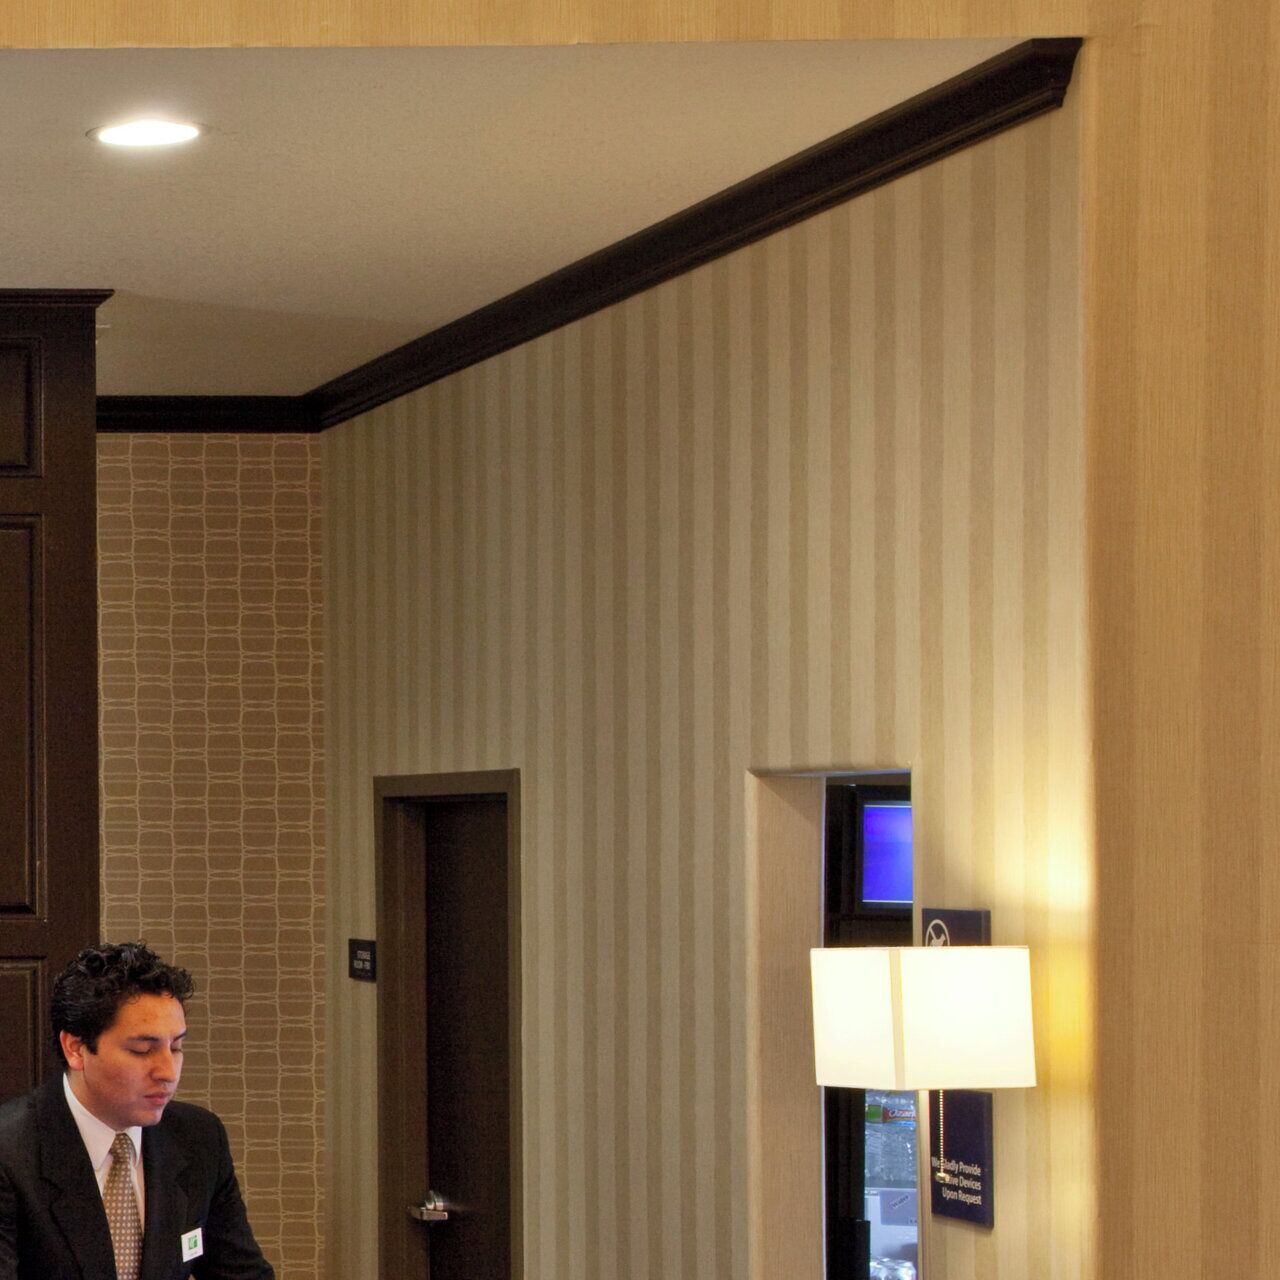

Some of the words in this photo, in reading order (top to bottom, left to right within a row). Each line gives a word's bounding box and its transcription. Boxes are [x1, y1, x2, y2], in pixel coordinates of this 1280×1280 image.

[959, 1161, 981, 1176] Provide
[959, 1176, 981, 1190] Devices
[942, 1187, 958, 1200] Upon
[958, 1190, 982, 1206] Request
